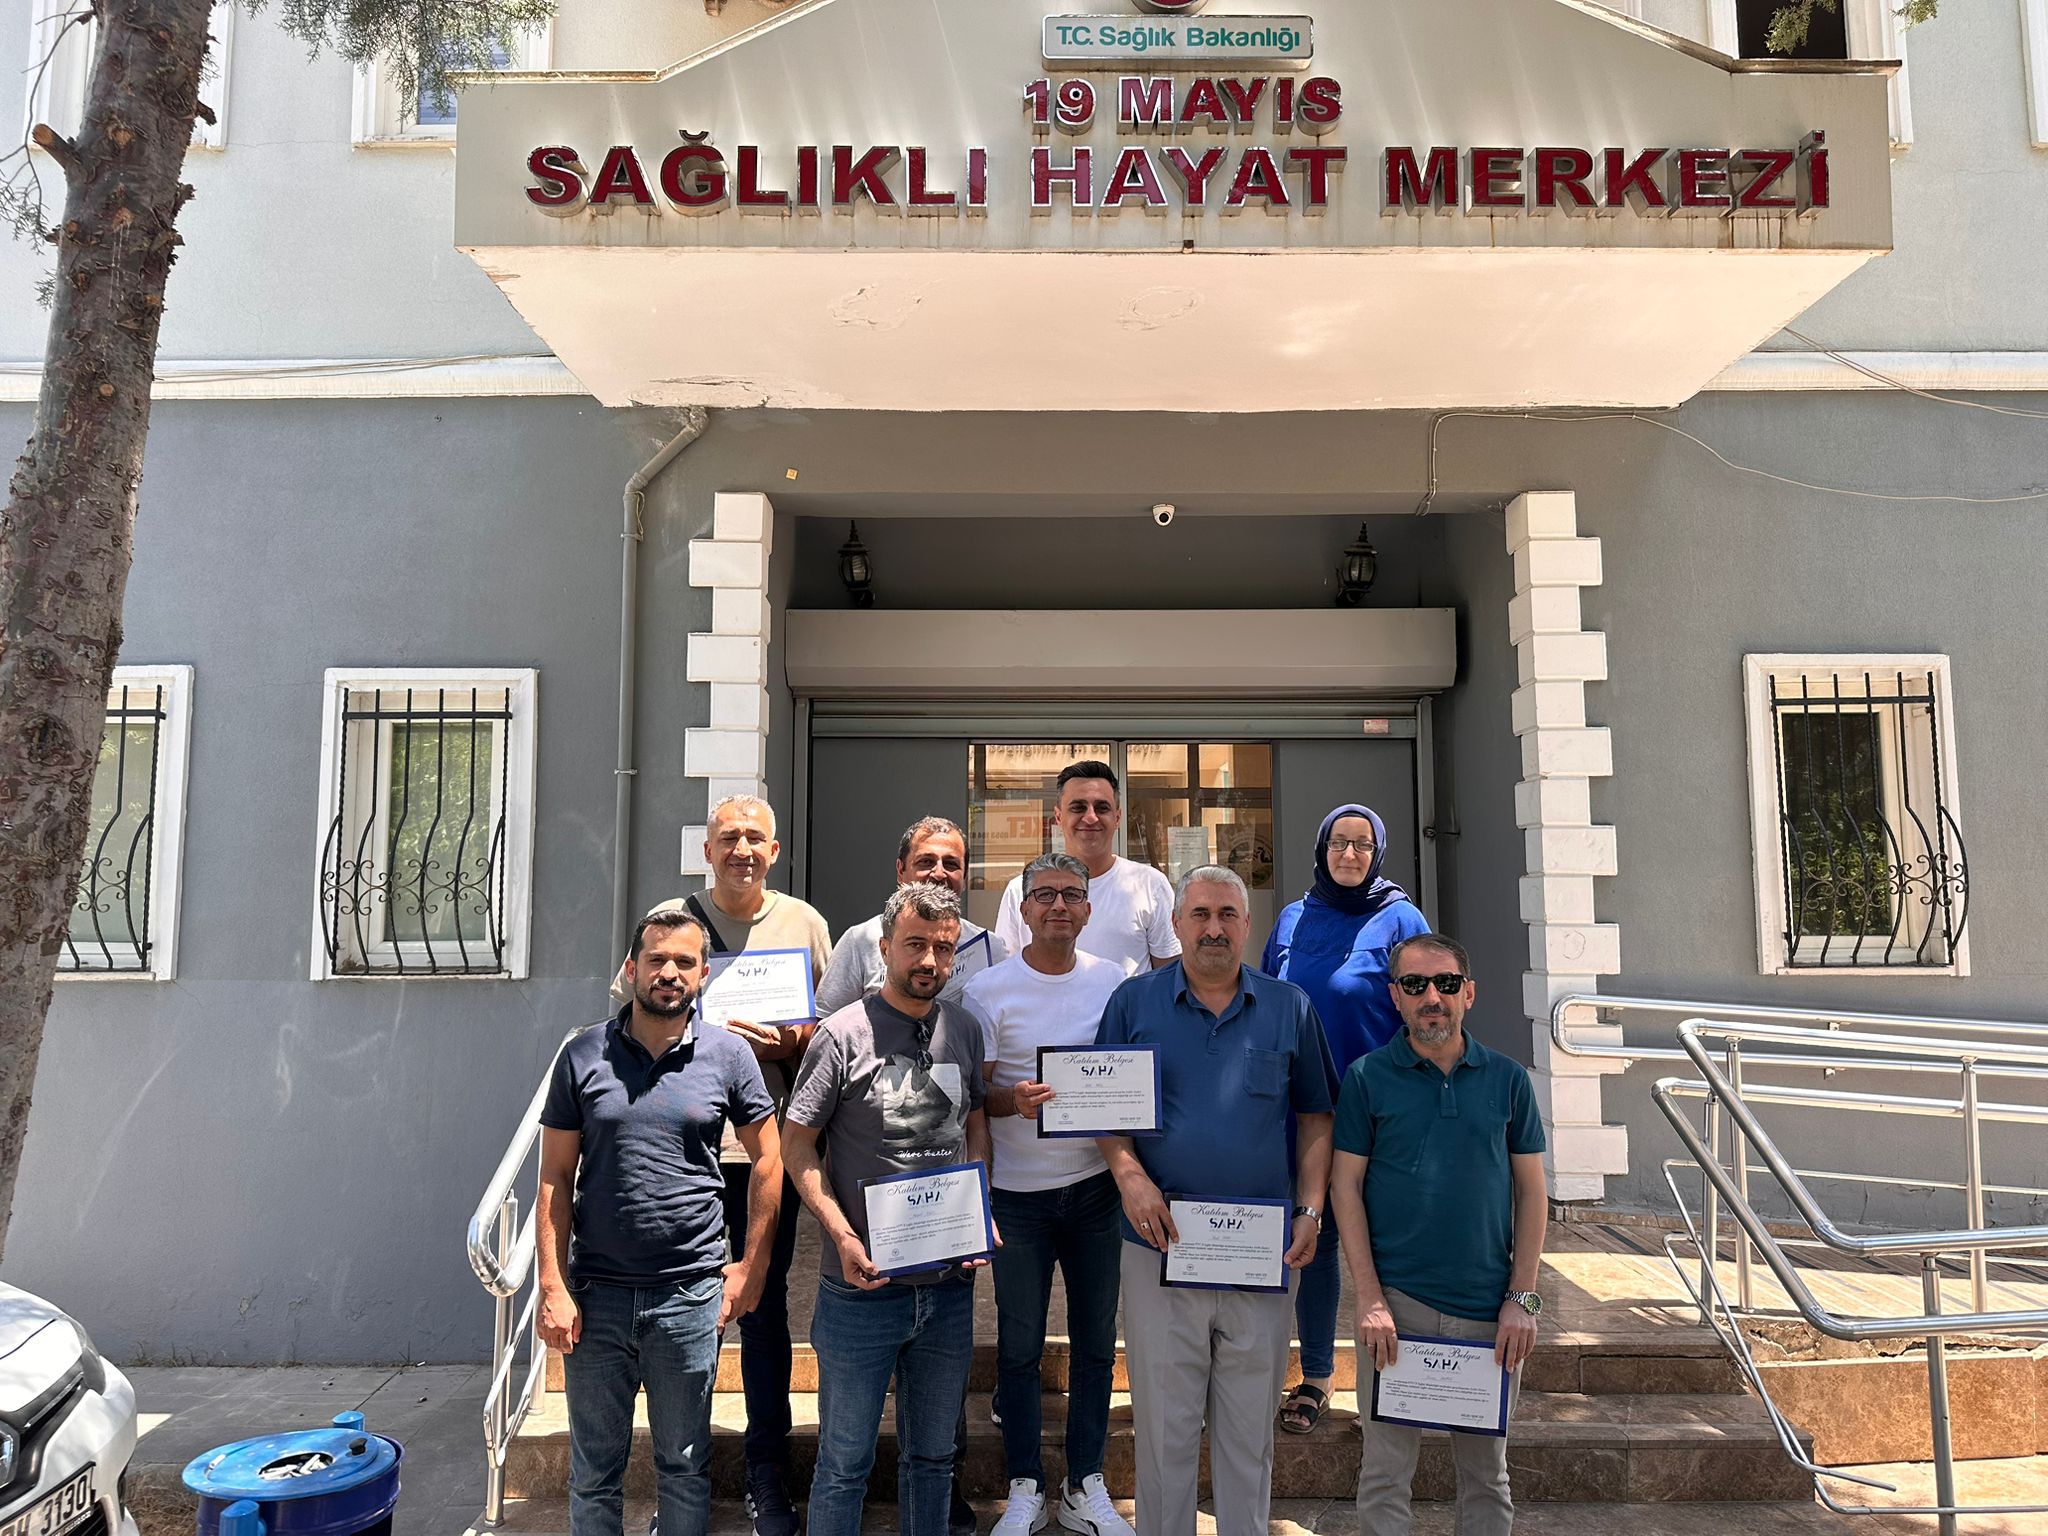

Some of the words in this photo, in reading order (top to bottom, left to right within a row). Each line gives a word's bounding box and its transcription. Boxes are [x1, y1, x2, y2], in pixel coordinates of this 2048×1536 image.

[1056, 26, 1094, 46] T.C.
[1099, 26, 1176, 52] Sağlık
[1187, 27, 1300, 52] Bakanlığı
[1023, 77, 1097, 130] 19
[1117, 77, 1343, 130] MAYIS
[525, 130, 988, 213] SAĞLIKLI
[1030, 146, 1347, 213] HAYAT
[1382, 130, 1830, 213] MERKEZİ
[41, 1474, 88, 1535] 3130
